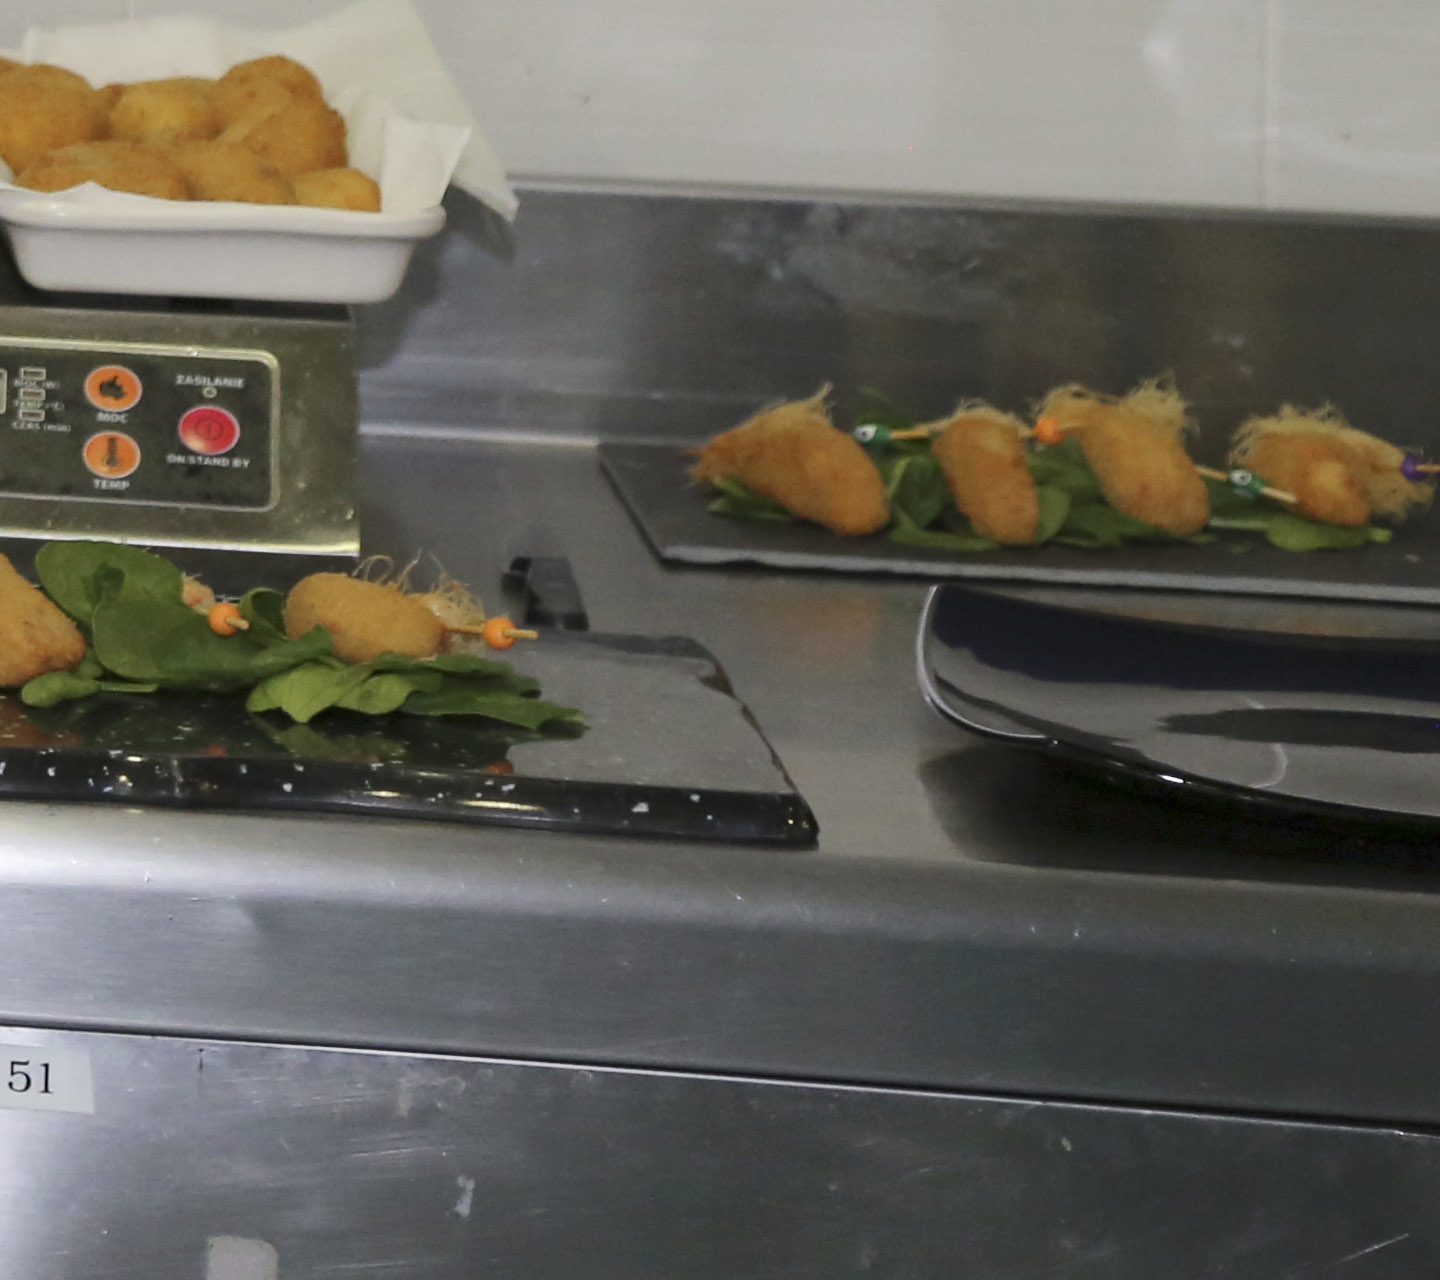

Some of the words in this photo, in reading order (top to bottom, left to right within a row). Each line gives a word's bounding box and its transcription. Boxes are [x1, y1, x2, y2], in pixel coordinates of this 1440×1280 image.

[96, 412, 129, 423] MOC
[93, 479, 129, 490] TEMP
[8, 1060, 53, 1094] 51
